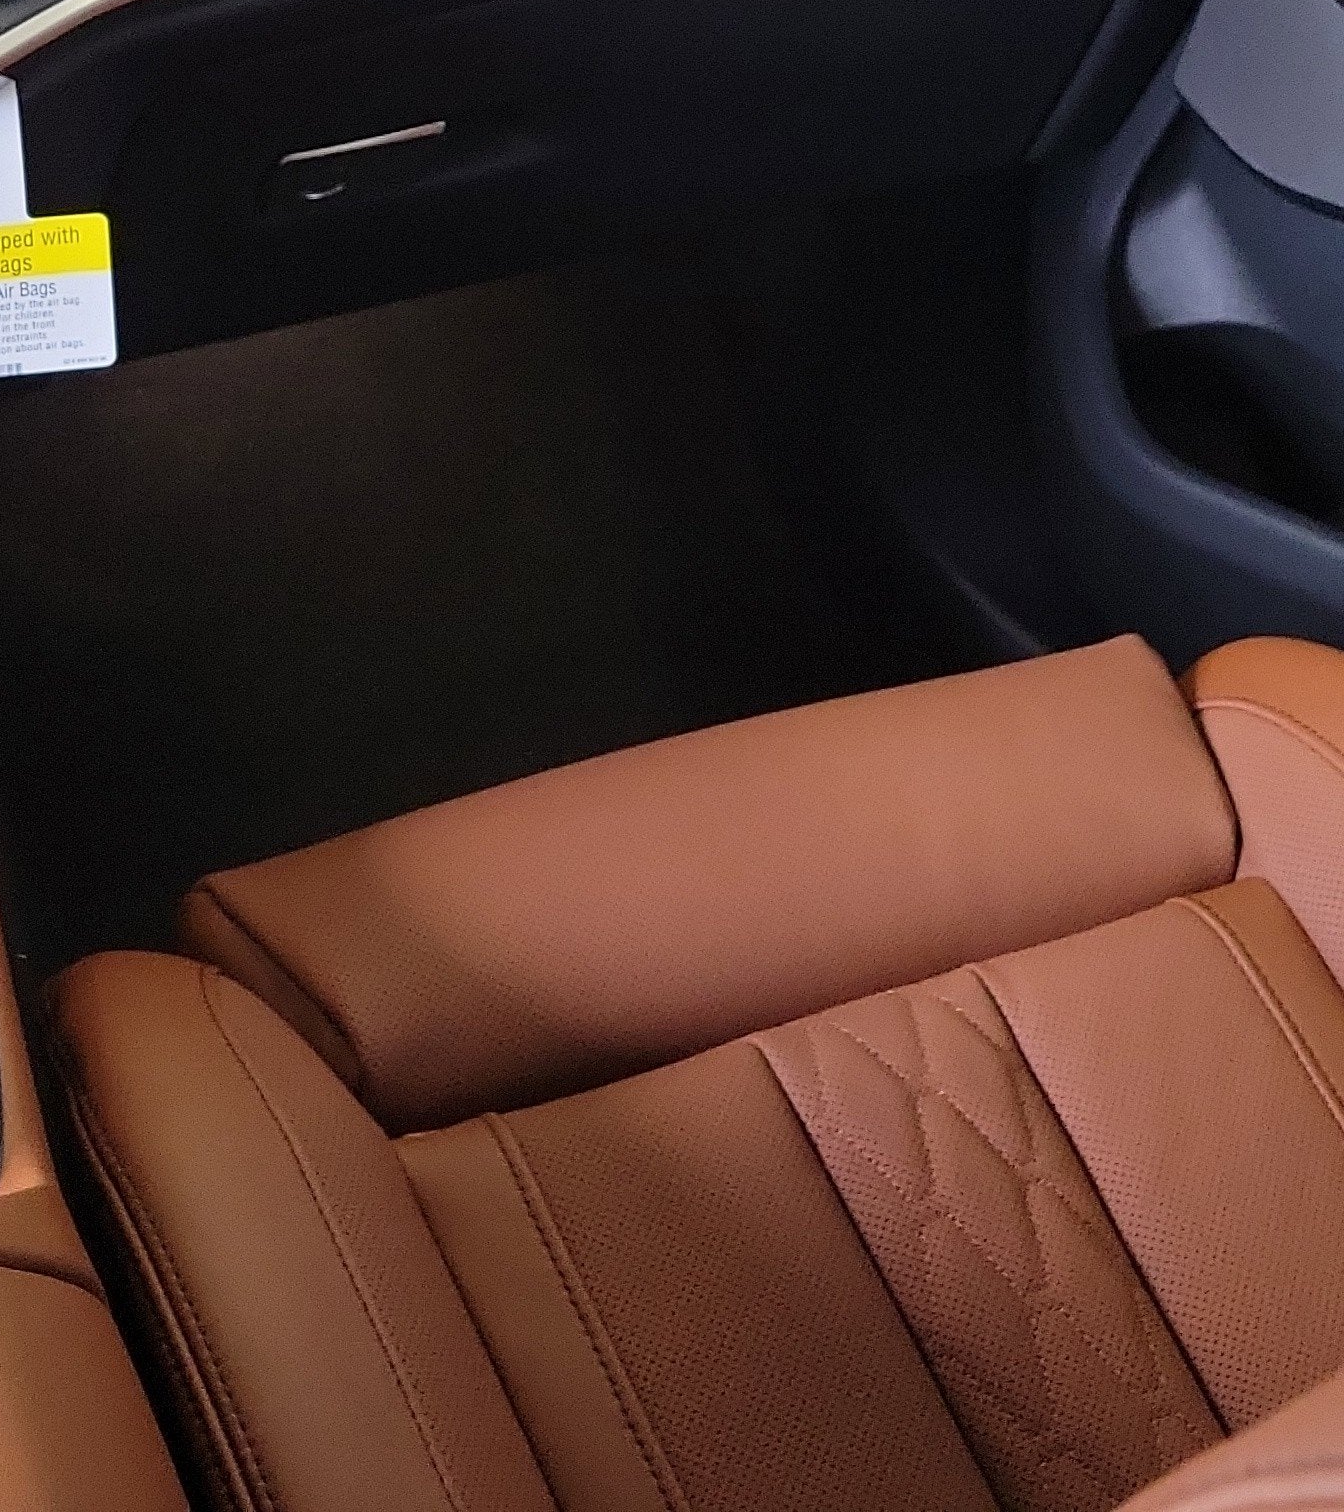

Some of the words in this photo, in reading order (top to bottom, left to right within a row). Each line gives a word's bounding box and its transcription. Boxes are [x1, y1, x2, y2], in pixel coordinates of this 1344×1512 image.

[41, 226, 80, 246] with
[19, 281, 58, 298] Bags
[14, 300, 26, 311] by
[29, 298, 44, 308] the
[47, 297, 60, 306] air
[1, 323, 11, 333] in
[14, 321, 28, 331] the
[15, 342, 43, 353] about
[46, 341, 58, 350] air
